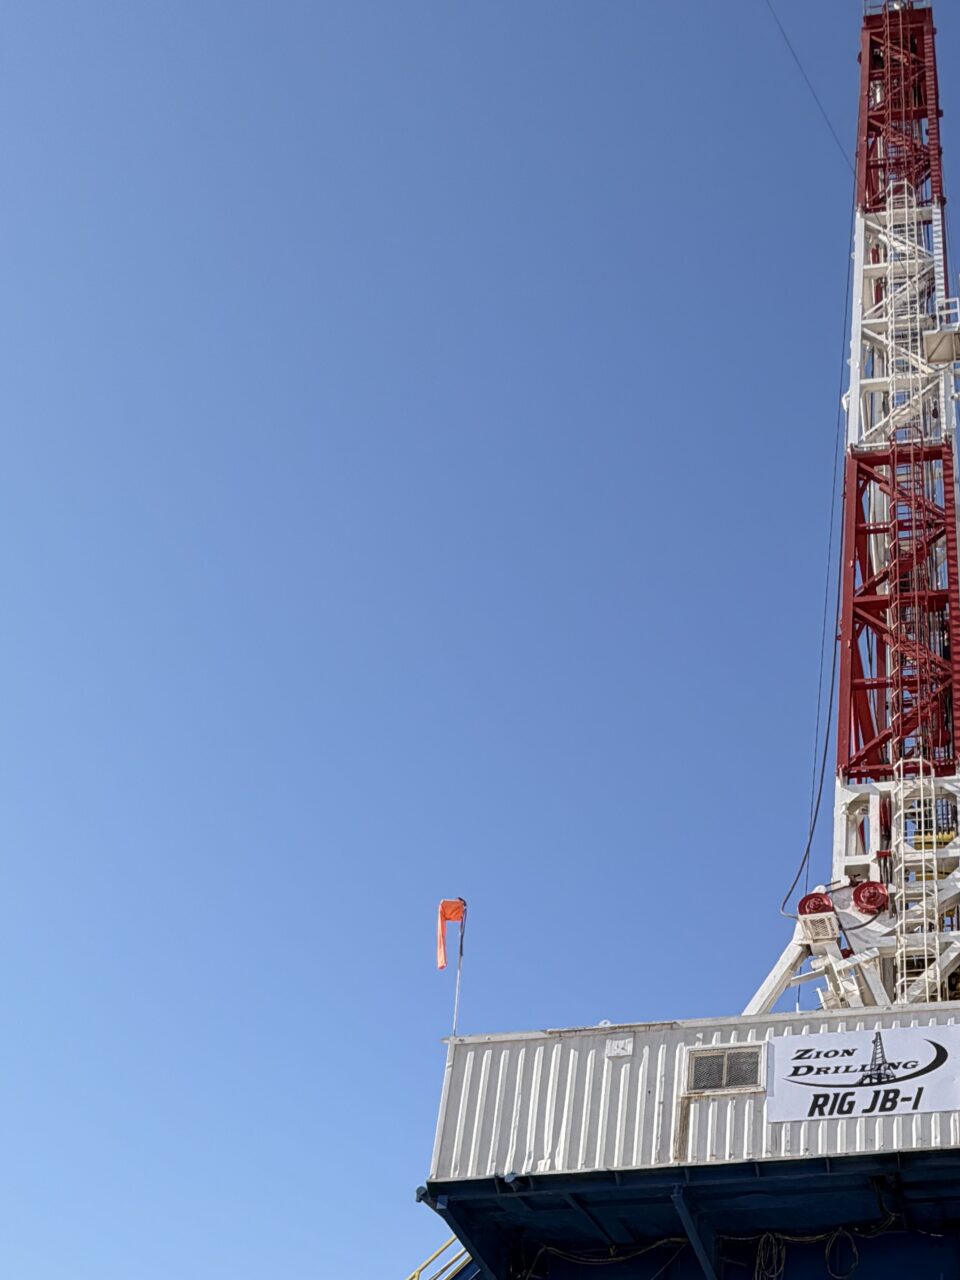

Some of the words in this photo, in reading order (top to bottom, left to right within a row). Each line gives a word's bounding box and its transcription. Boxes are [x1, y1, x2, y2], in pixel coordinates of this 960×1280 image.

[791, 1048, 858, 1061] ZION
[787, 1060, 919, 1077] DRILLING
[807, 1091, 856, 1118] RIG
